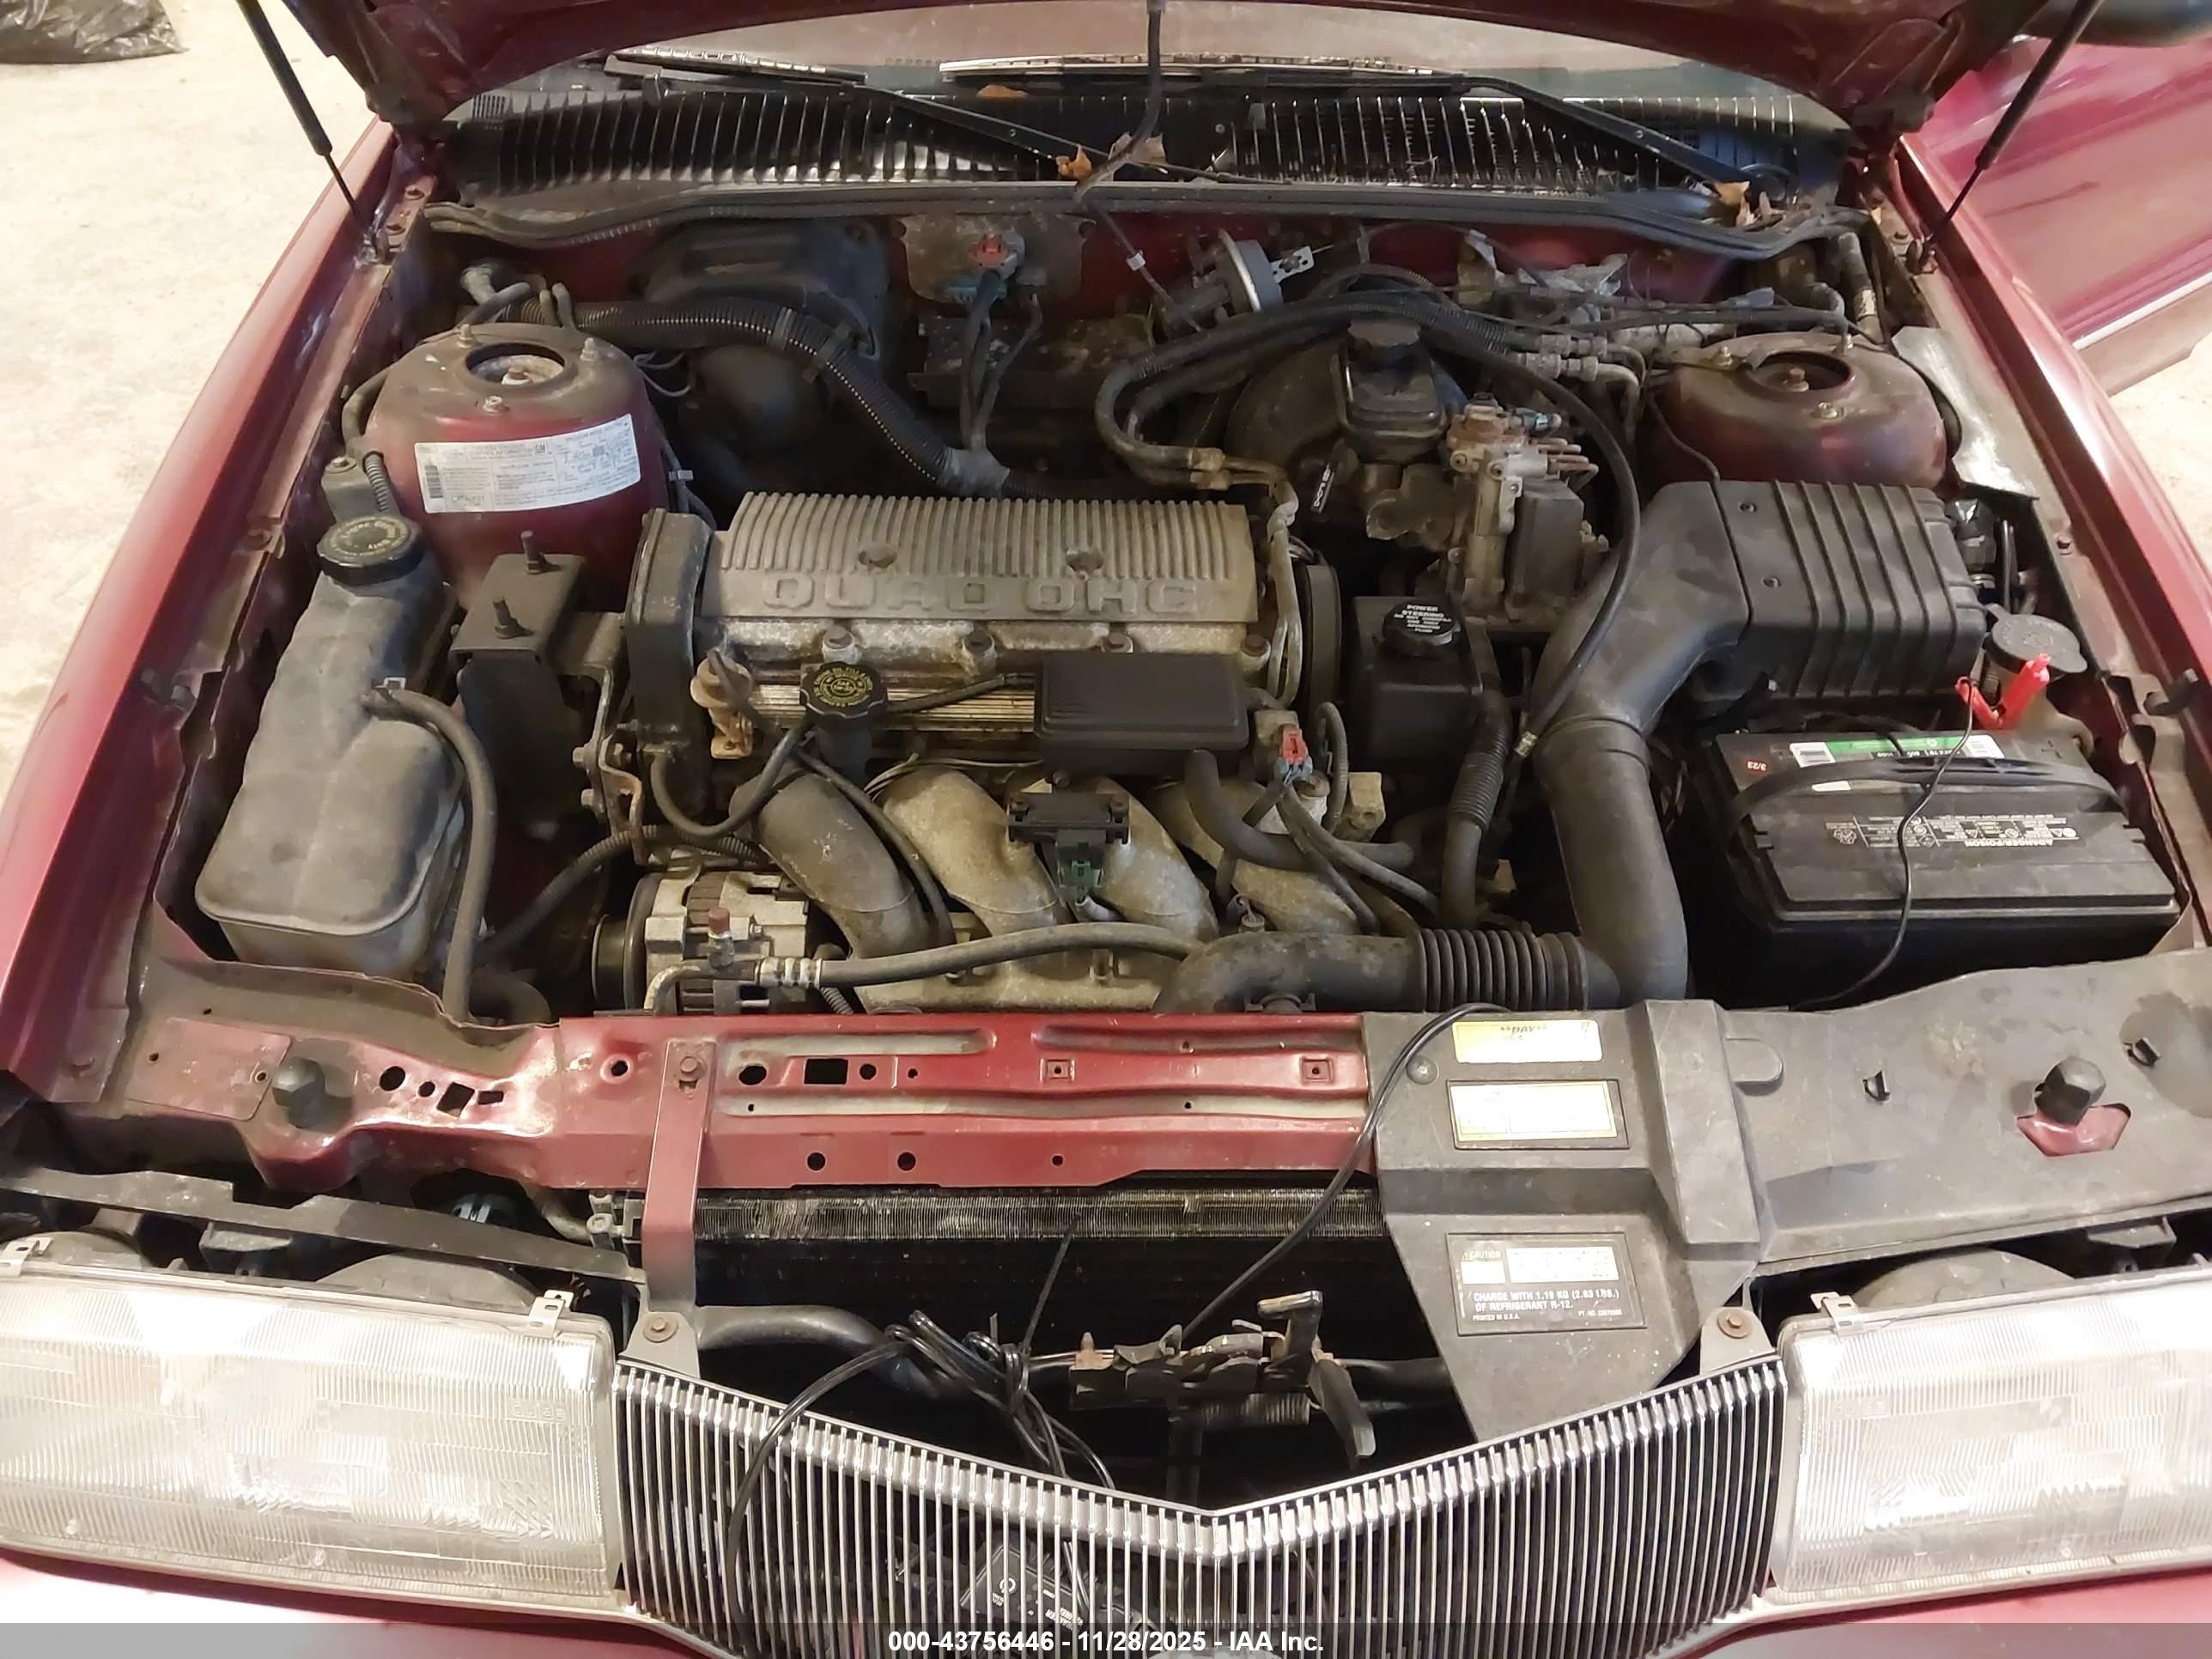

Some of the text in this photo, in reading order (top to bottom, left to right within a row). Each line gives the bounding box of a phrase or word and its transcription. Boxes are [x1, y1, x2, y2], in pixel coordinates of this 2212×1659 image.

[763, 573, 1201, 617] QUAD OHC
[1402, 610, 1444, 618] STEERING
[1469, 1249, 1501, 1259] CAUTION
[1474, 1291, 1509, 1302] CHARGE
[1510, 1291, 1534, 1301] WITH
[1556, 1290, 1570, 1300] KG
[1475, 1300, 1574, 1312] OF REFRIGERANT R-12.
